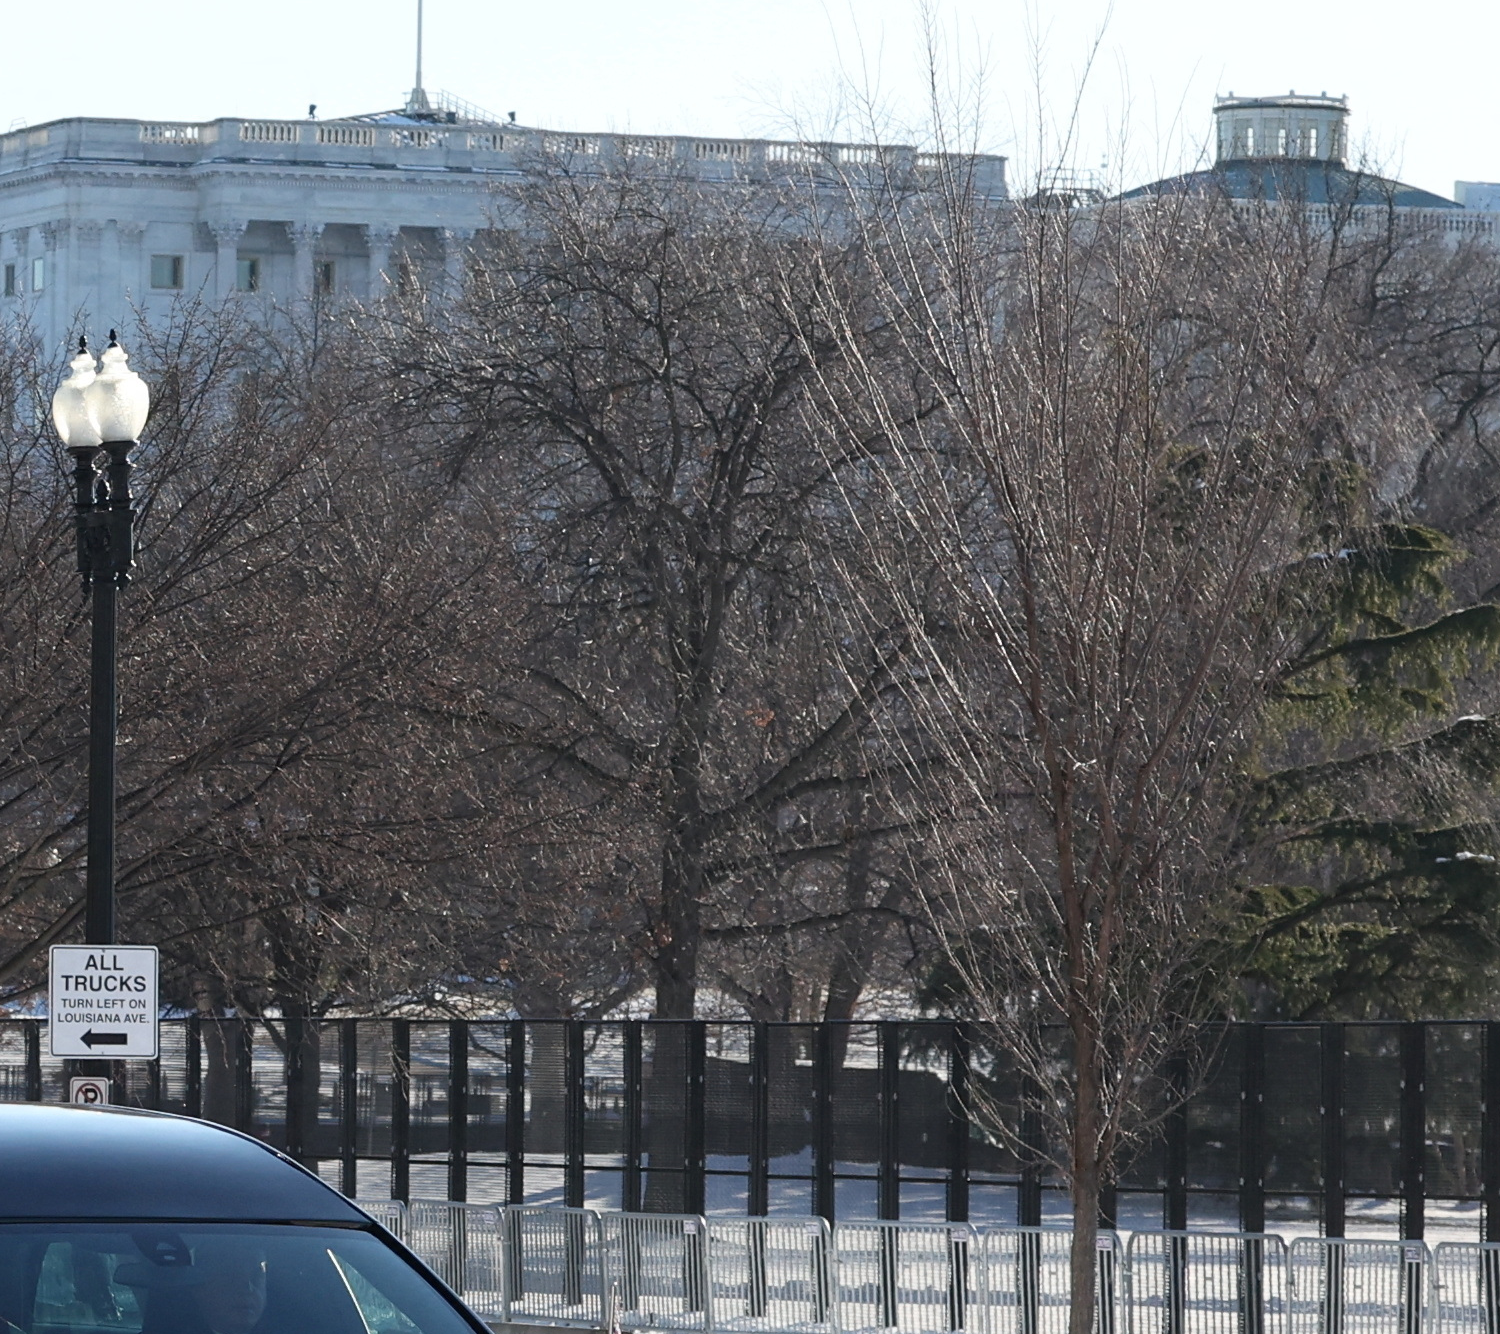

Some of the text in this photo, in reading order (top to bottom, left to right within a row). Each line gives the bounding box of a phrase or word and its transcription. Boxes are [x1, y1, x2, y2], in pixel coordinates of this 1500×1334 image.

[84, 955, 124, 971] ALL
[61, 975, 146, 992] TRUCKS
[61, 998, 146, 1009] TURN LEFT ON
[57, 1013, 150, 1023] LOUISIANA AVE.
